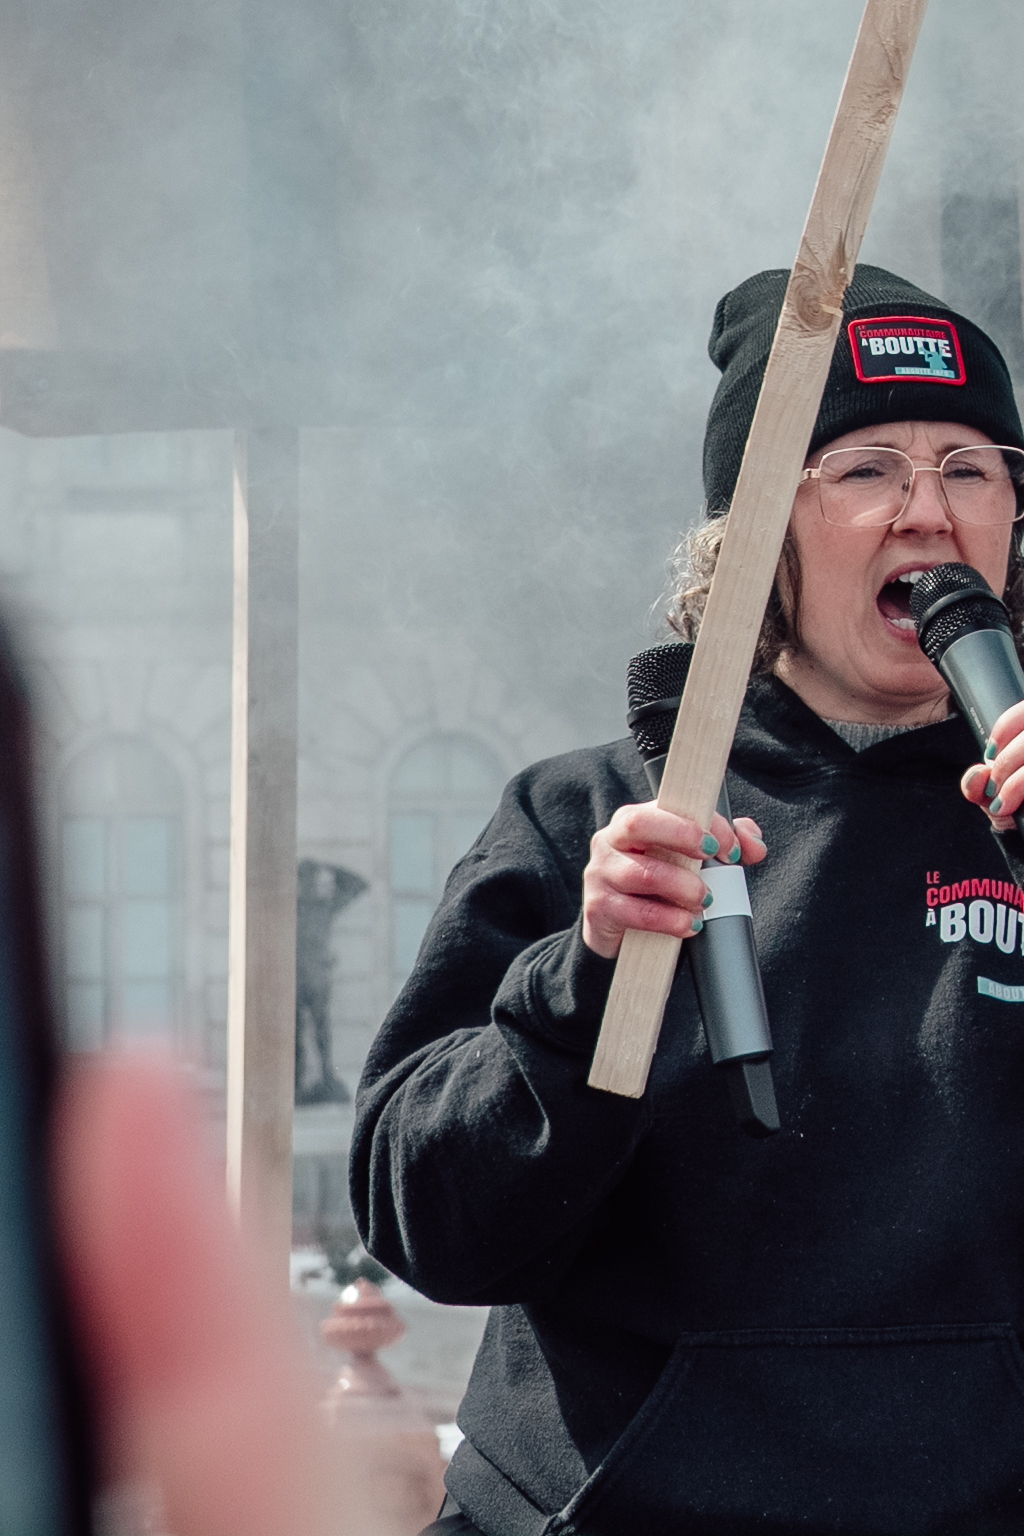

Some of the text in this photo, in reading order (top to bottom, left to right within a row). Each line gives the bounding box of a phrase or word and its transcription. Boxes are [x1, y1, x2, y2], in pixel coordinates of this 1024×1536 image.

[860, 328, 946, 339] COMMUNAUTAIRE
[869, 337, 952, 357] BOUTTE
[926, 871, 940, 884] LE
[926, 878, 1024, 908] COMMUNA
